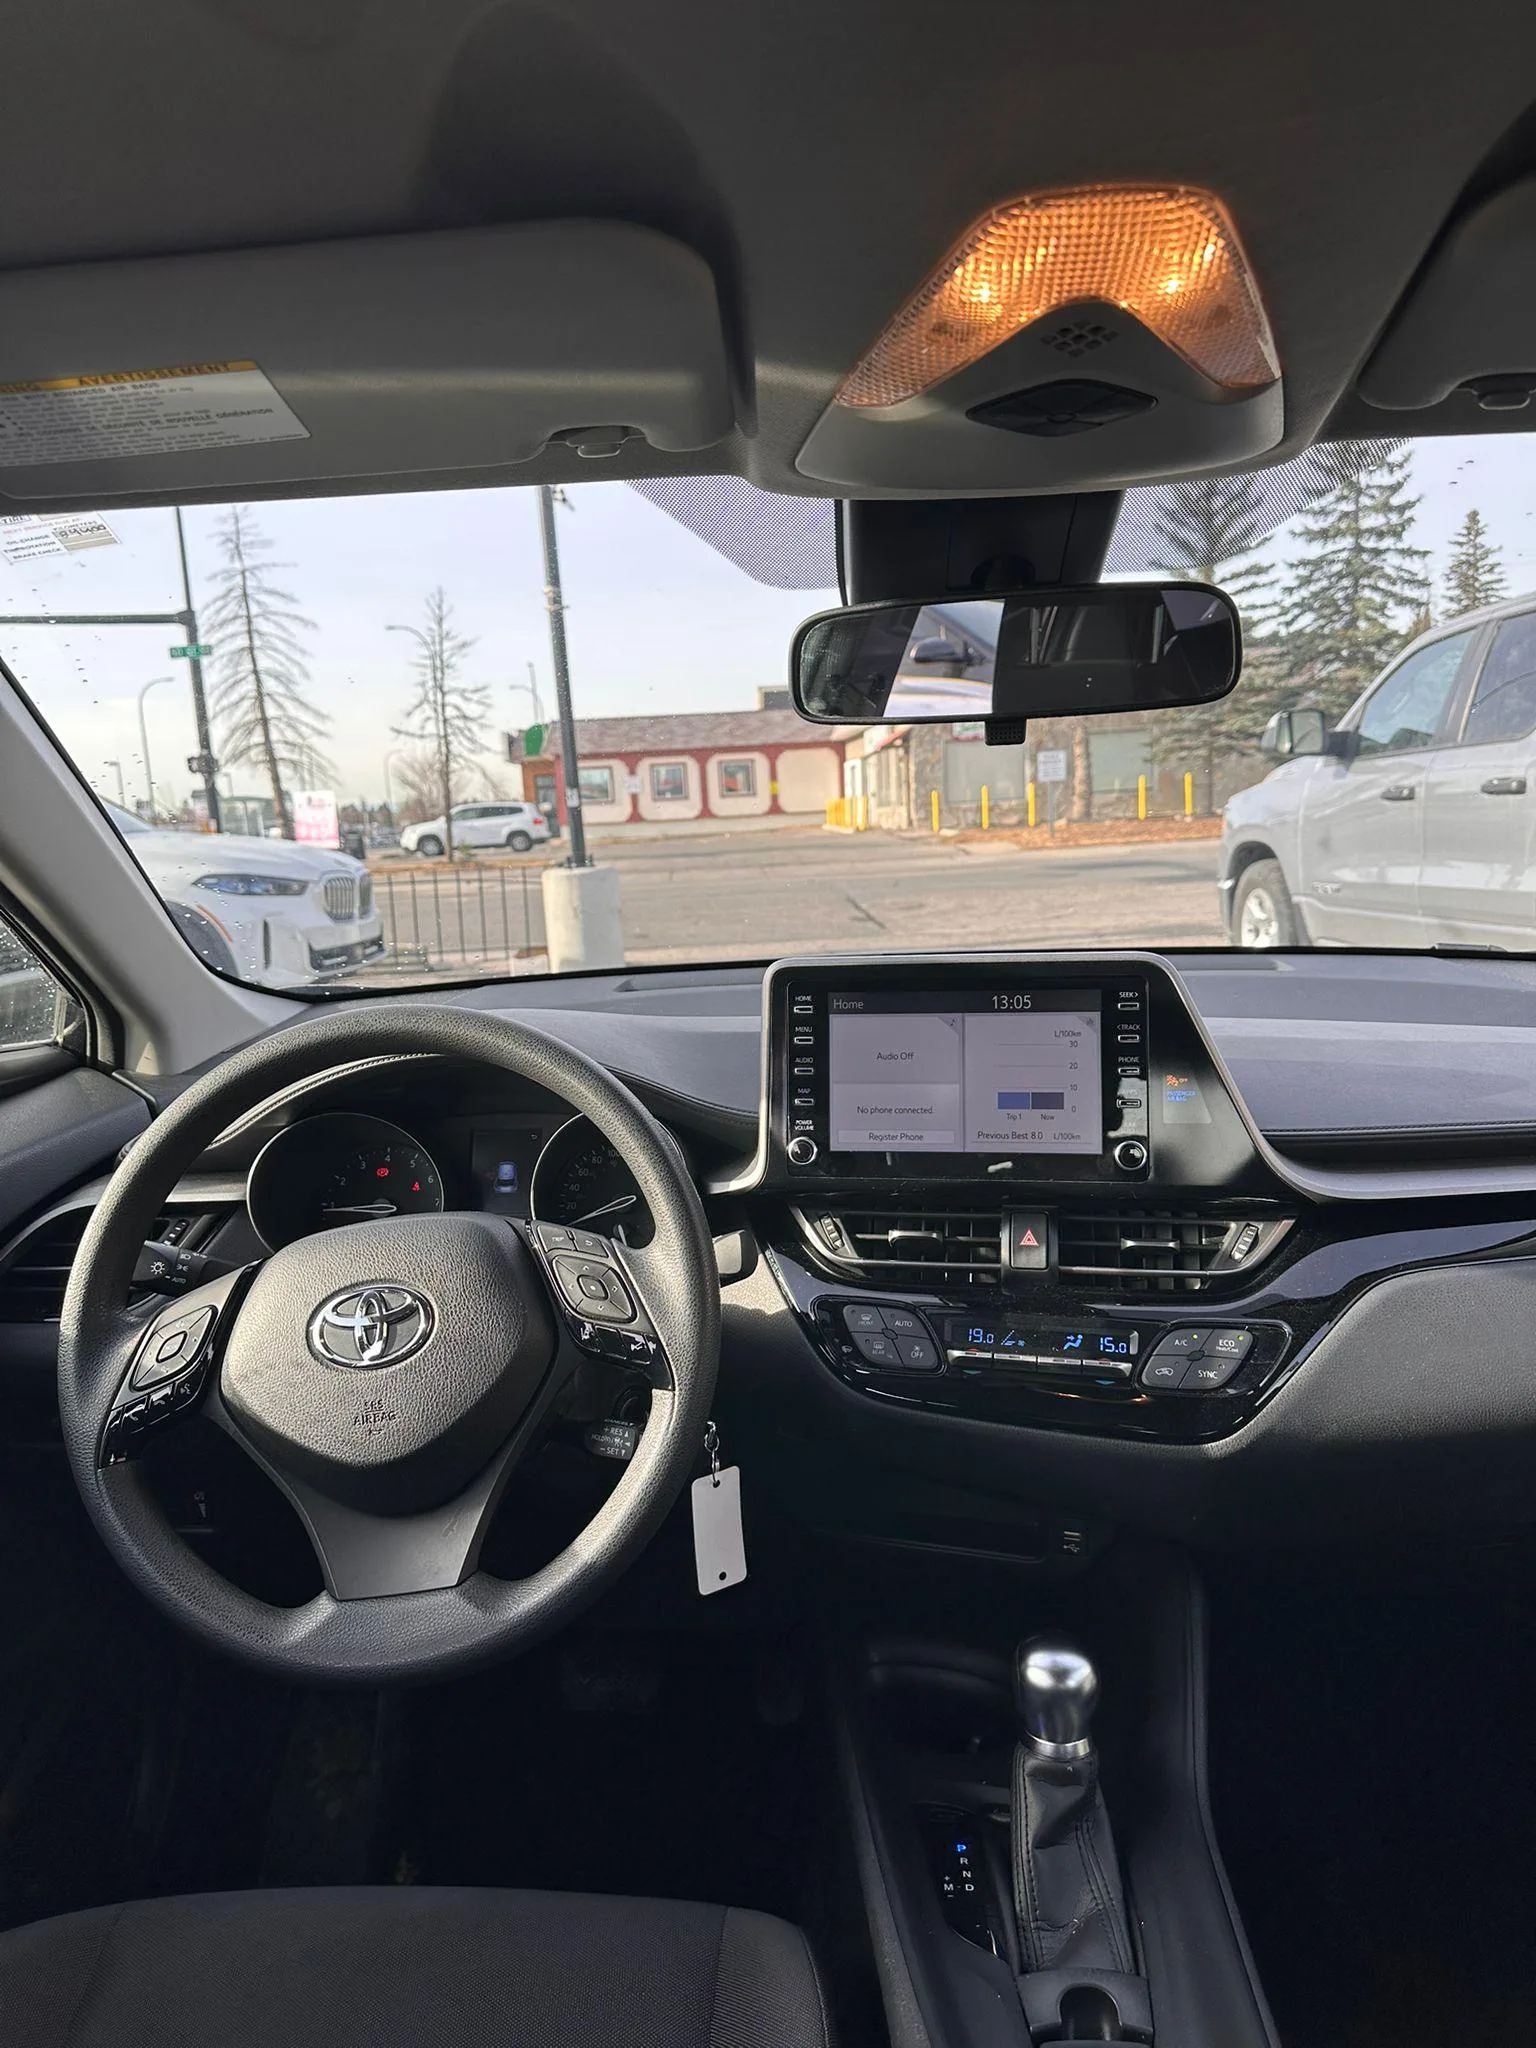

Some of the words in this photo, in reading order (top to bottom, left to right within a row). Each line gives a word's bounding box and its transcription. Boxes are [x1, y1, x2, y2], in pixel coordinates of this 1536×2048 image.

[832, 998, 865, 1011] Home
[991, 994, 1033, 1010] 13:05
[1053, 1029, 1083, 1039] L/100km
[1068, 1040, 1079, 1049] 30
[794, 1056, 814, 1064] AUDIO
[876, 1052, 899, 1061] Audio
[900, 1051, 915, 1061] Off
[1117, 1056, 1140, 1064] PHONE
[1068, 1062, 1079, 1071] 20
[1069, 1083, 1079, 1092] 10
[857, 1106, 869, 1114] No
[870, 1106, 893, 1115] phone
[1071, 1105, 1077, 1113] 0
[1006, 1112, 1018, 1121] Trip
[868, 1132, 899, 1142] Register
[899, 1132, 924, 1141] Phone
[977, 1131, 1010, 1140] Previous
[1011, 1130, 1028, 1140] Best
[1053, 1132, 1081, 1140] L/100km
[578, 1168, 589, 1177] 60
[569, 1183, 580, 1192] 40
[968, 1328, 994, 1344] 19.0
[1100, 1336, 1127, 1354] 15.0
[1174, 1339, 1189, 1347] A/C
[1219, 1339, 1235, 1347] ECO
[911, 1351, 923, 1359] OFF
[1198, 1369, 1218, 1379] SYNC
[353, 1410, 398, 1427] AIRBAG
[606, 1448, 620, 1456] SET
[956, 1844, 967, 1852] P
[960, 1857, 968, 1865] R
[962, 1870, 972, 1878] N
[944, 1883, 954, 1891] M
